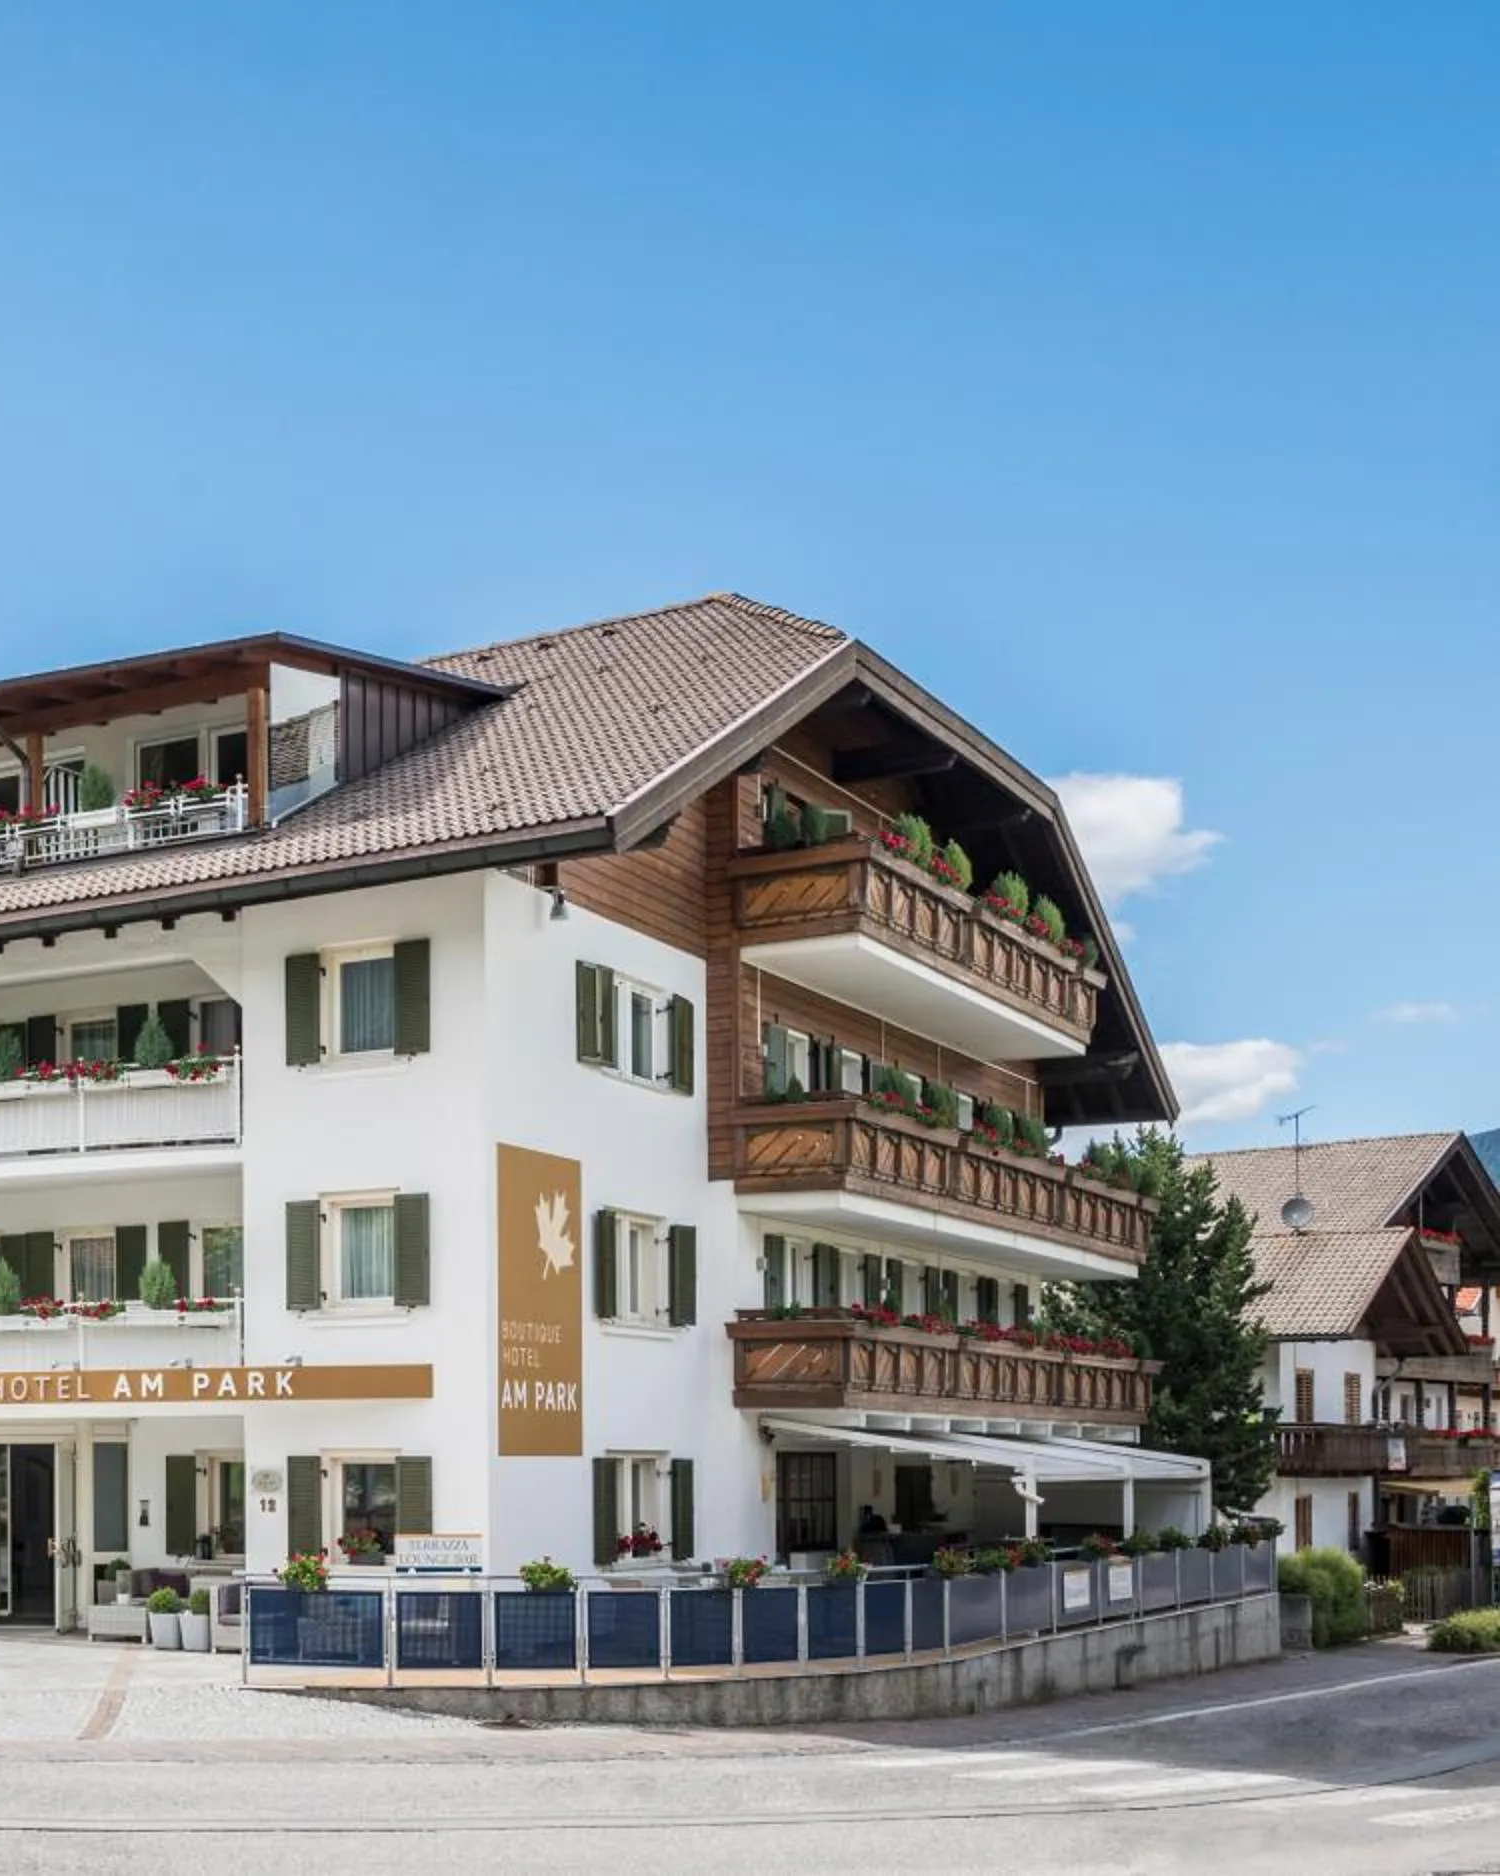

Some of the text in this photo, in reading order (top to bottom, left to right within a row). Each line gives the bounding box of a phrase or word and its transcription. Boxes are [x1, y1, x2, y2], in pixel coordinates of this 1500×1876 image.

[502, 1320, 562, 1343] BOUTIQUE
[503, 1345, 541, 1367] HOTEL
[113, 1372, 164, 1399] AM
[192, 1370, 293, 1397] PARK
[501, 1378, 577, 1412] AM PARK
